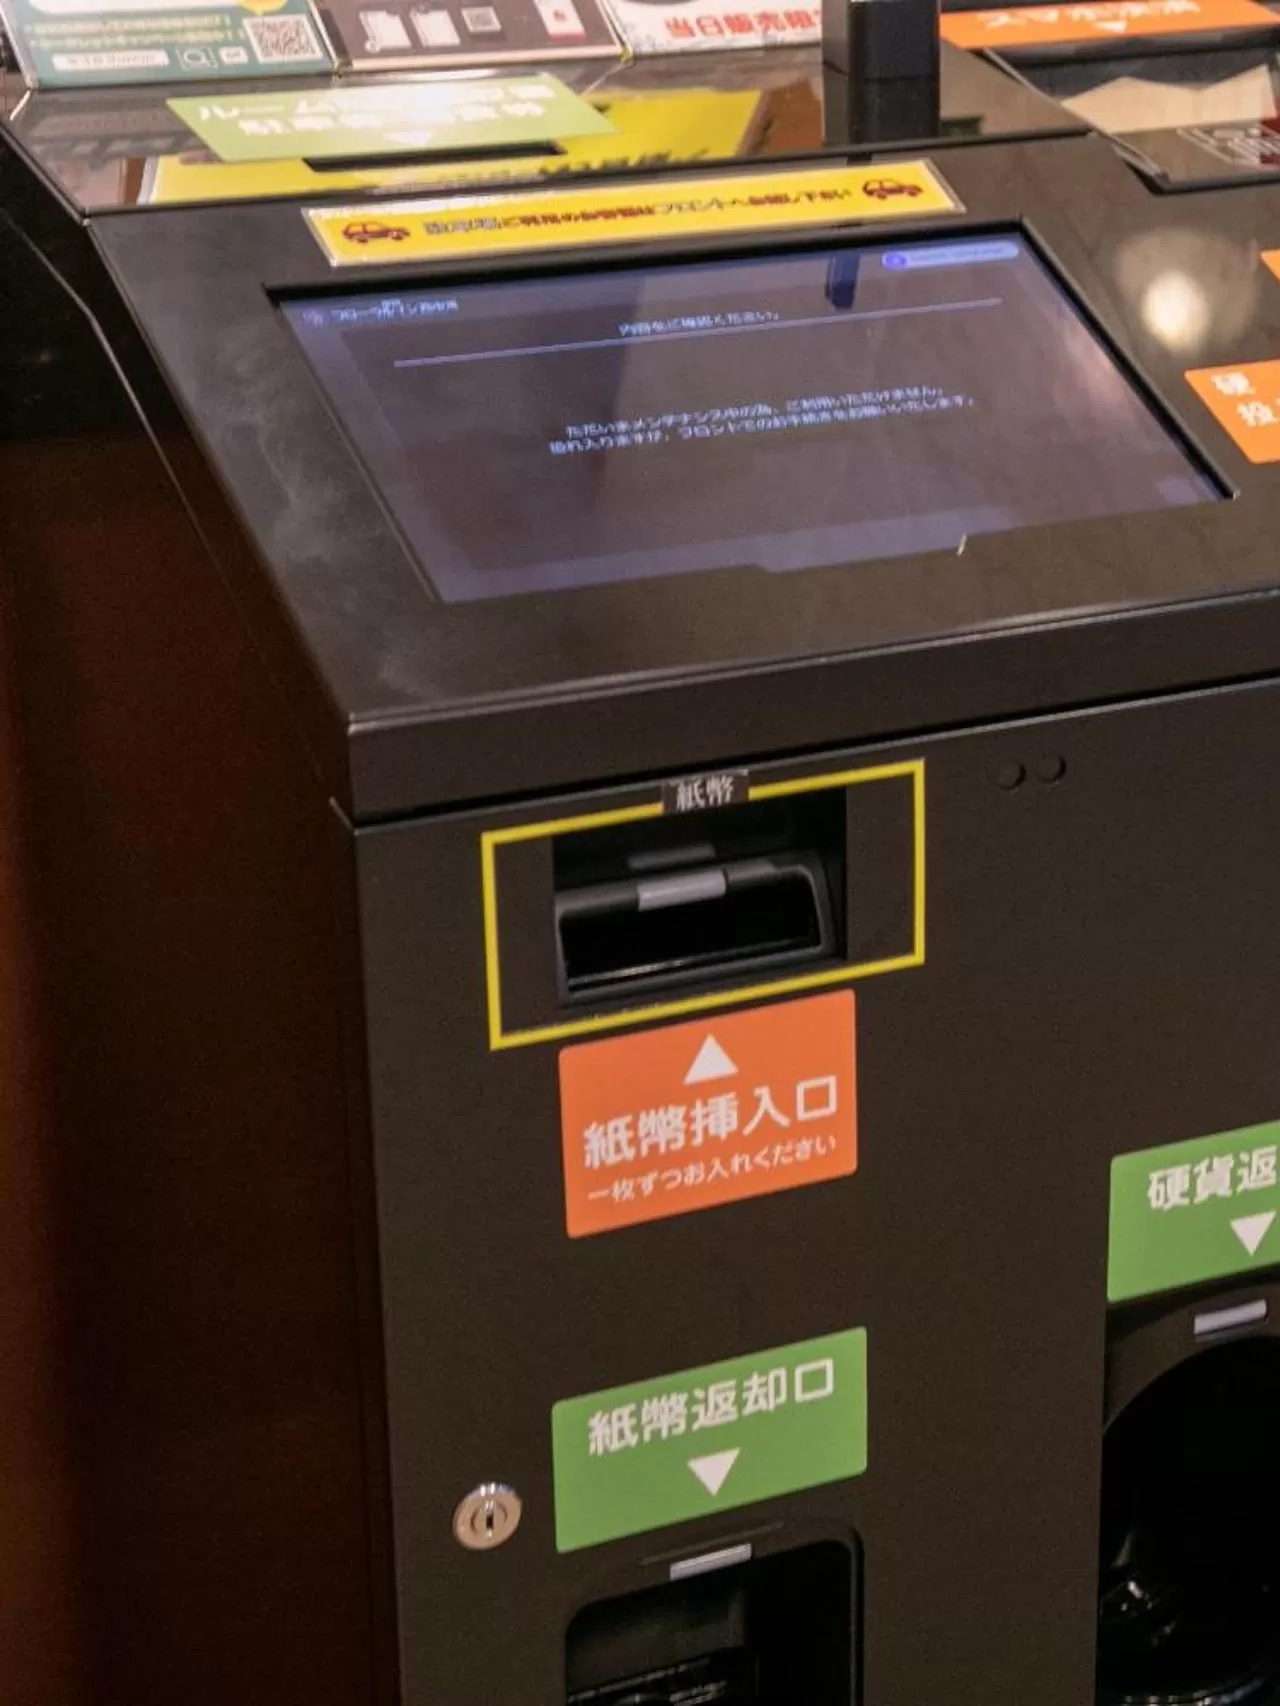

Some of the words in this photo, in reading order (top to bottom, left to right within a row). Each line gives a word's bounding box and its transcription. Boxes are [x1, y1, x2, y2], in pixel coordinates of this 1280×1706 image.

[676, 776, 734, 809] 紙幣
[583, 1075, 838, 1170] 紙幣挿入口
[587, 1135, 836, 1204] 一枚ずつお入れください
[586, 1358, 835, 1457] 紙幣返却口
